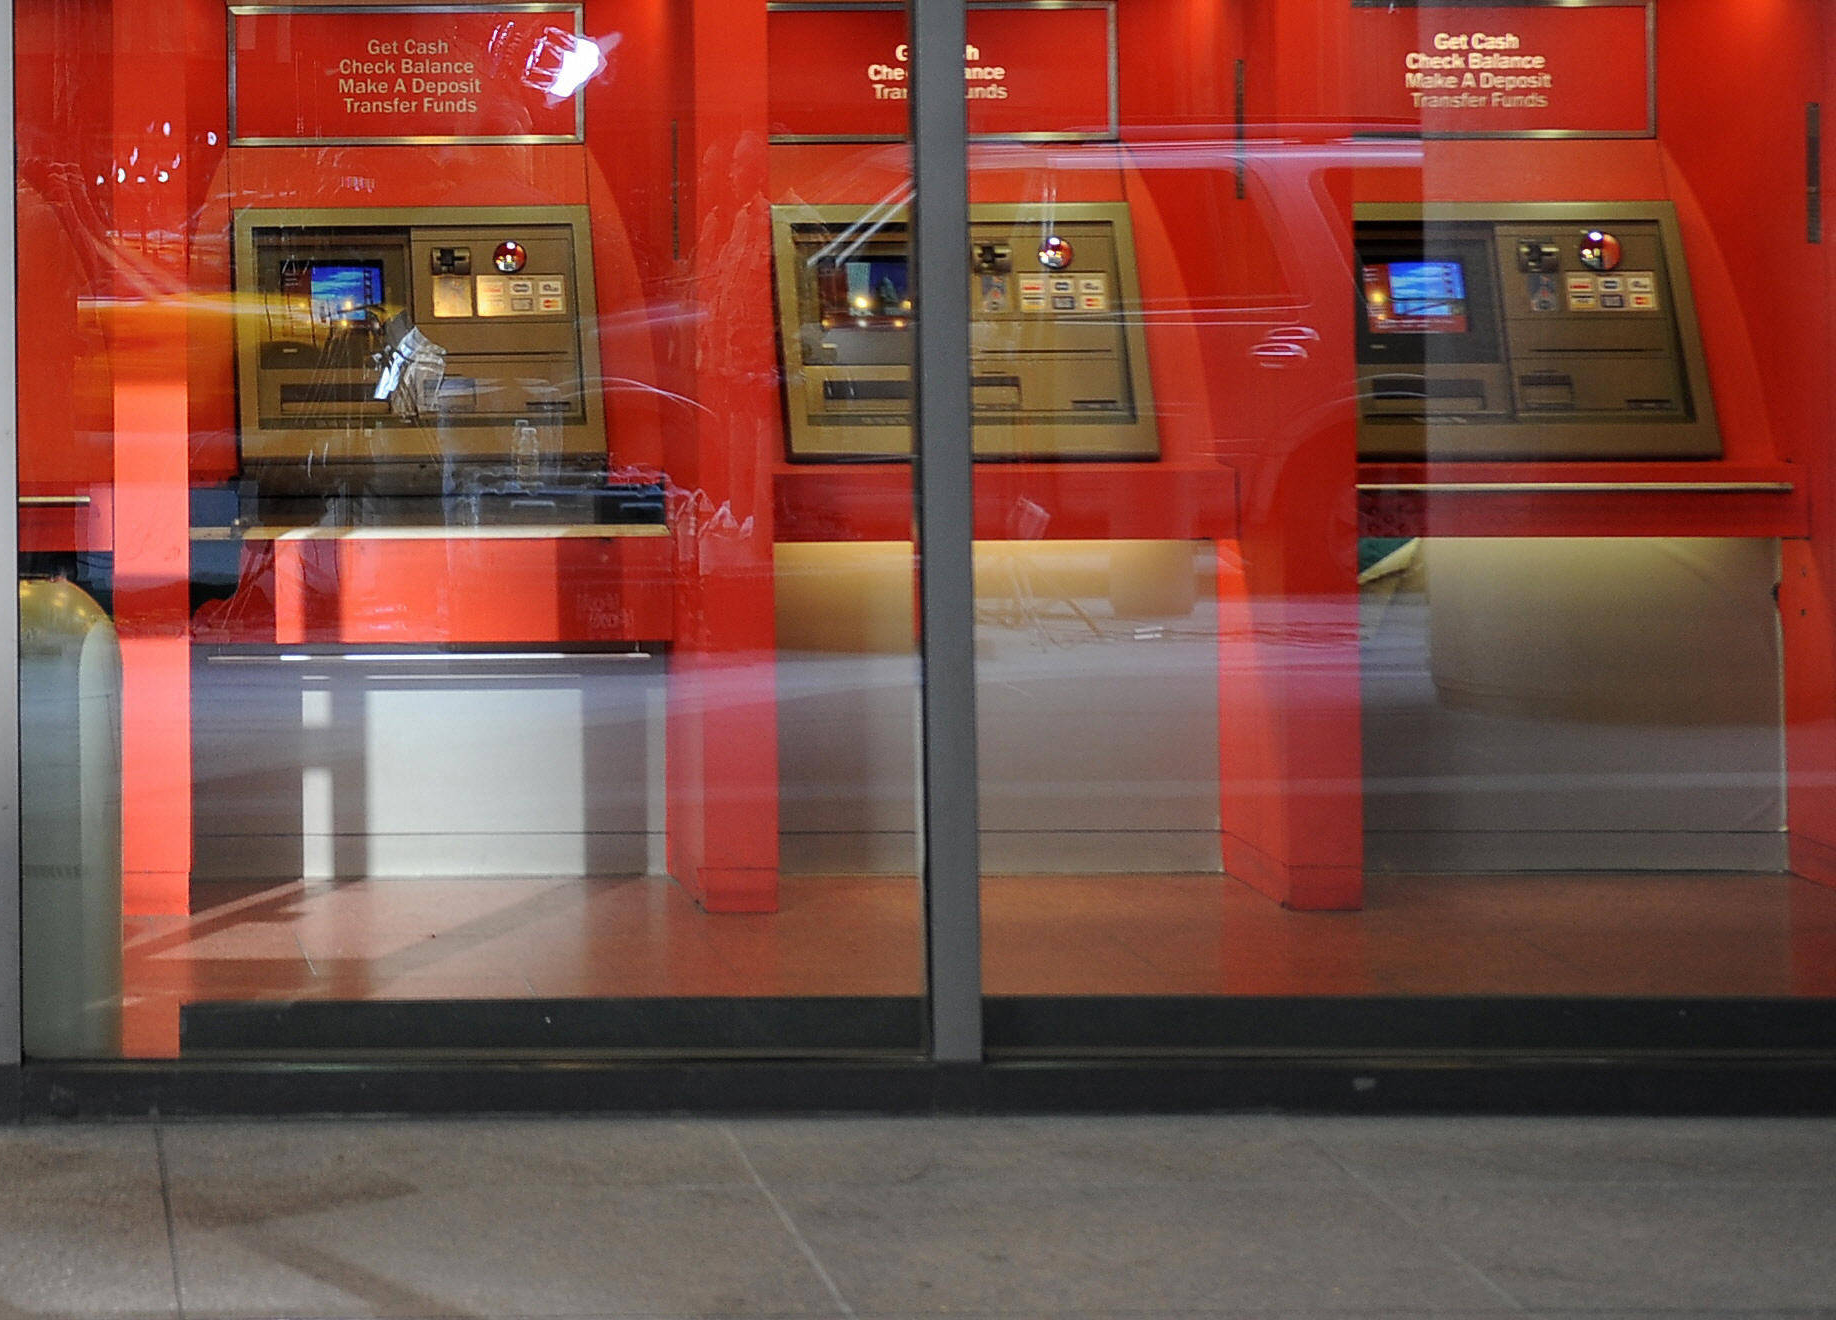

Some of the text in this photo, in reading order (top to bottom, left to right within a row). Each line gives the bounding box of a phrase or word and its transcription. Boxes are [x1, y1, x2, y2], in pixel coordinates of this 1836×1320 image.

[367, 38, 449, 55] Get Cash
[1434, 33, 1520, 50] Get Cash
[339, 59, 474, 75] Check Balance
[1405, 53, 1545, 70] Check Balance
[868, 64, 908, 81] Che
[339, 77, 482, 98] Make A Deposit
[1405, 72, 1552, 91] Make A Deposit
[343, 97, 477, 114] Transfer Funds
[1411, 91, 1549, 108] Transfer Funds
